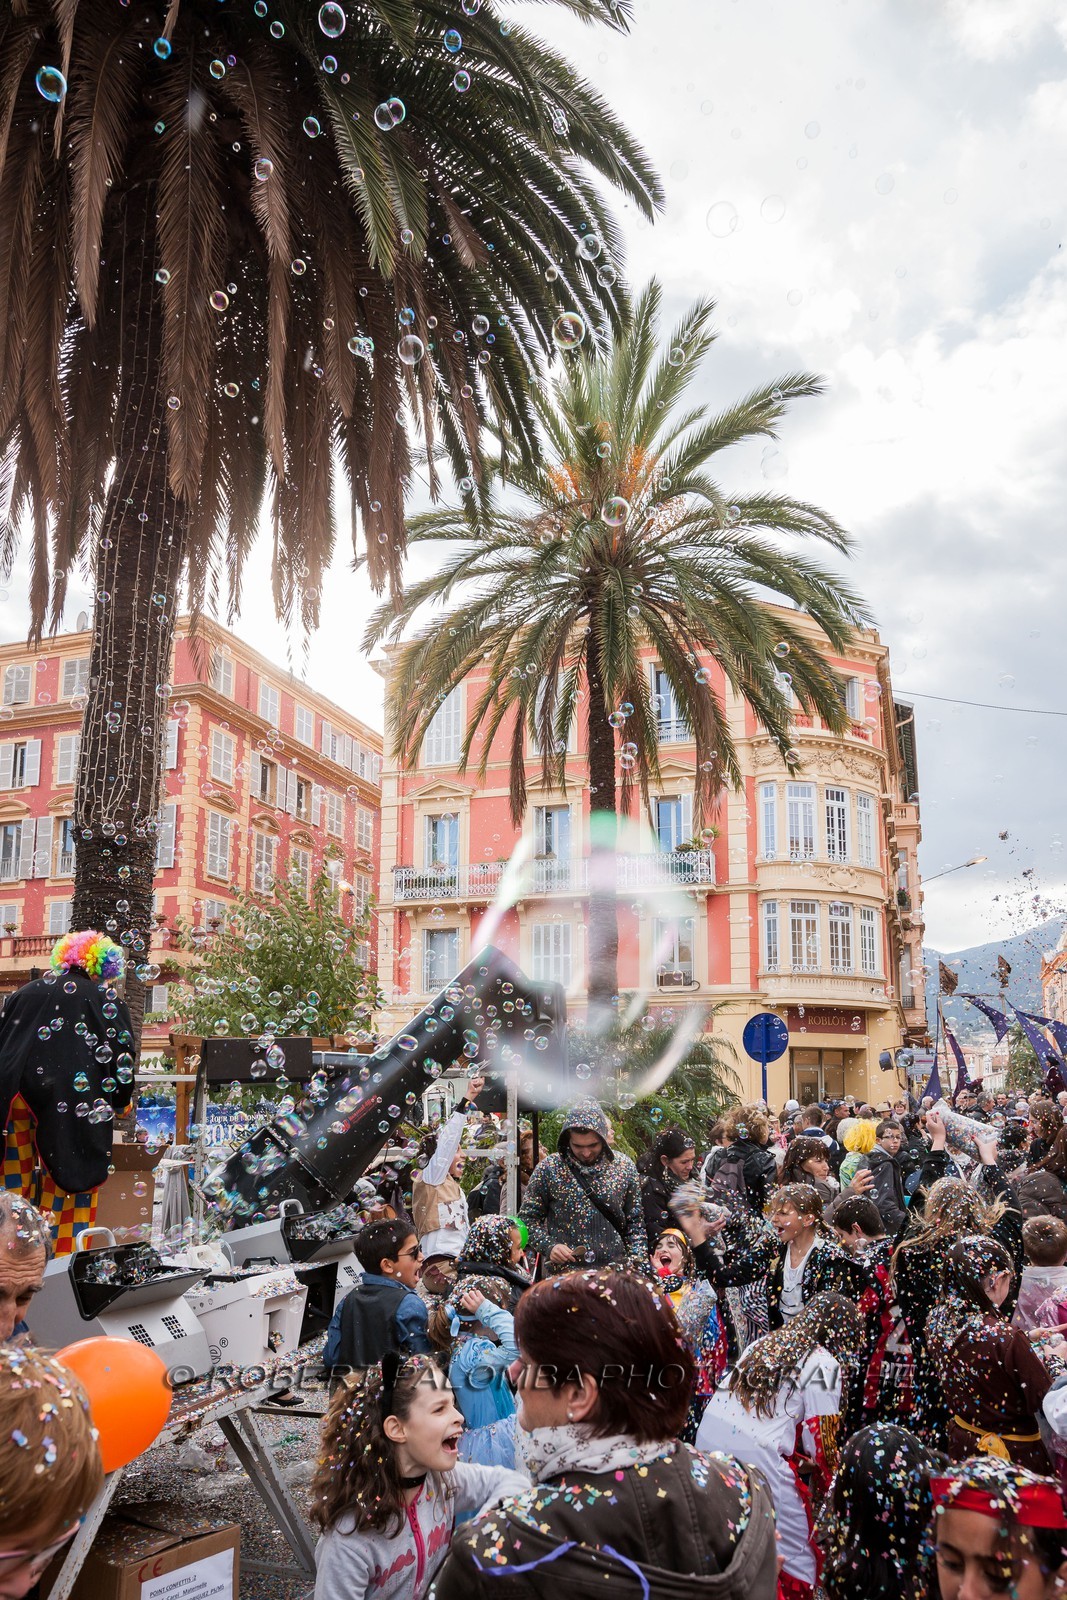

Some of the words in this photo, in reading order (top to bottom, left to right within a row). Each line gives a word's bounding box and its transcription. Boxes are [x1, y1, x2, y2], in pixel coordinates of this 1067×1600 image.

[149, 1586, 166, 1598] POINT
[166, 1577, 192, 1592] CONFETTIS
[182, 1581, 208, 1596] Maternelle
